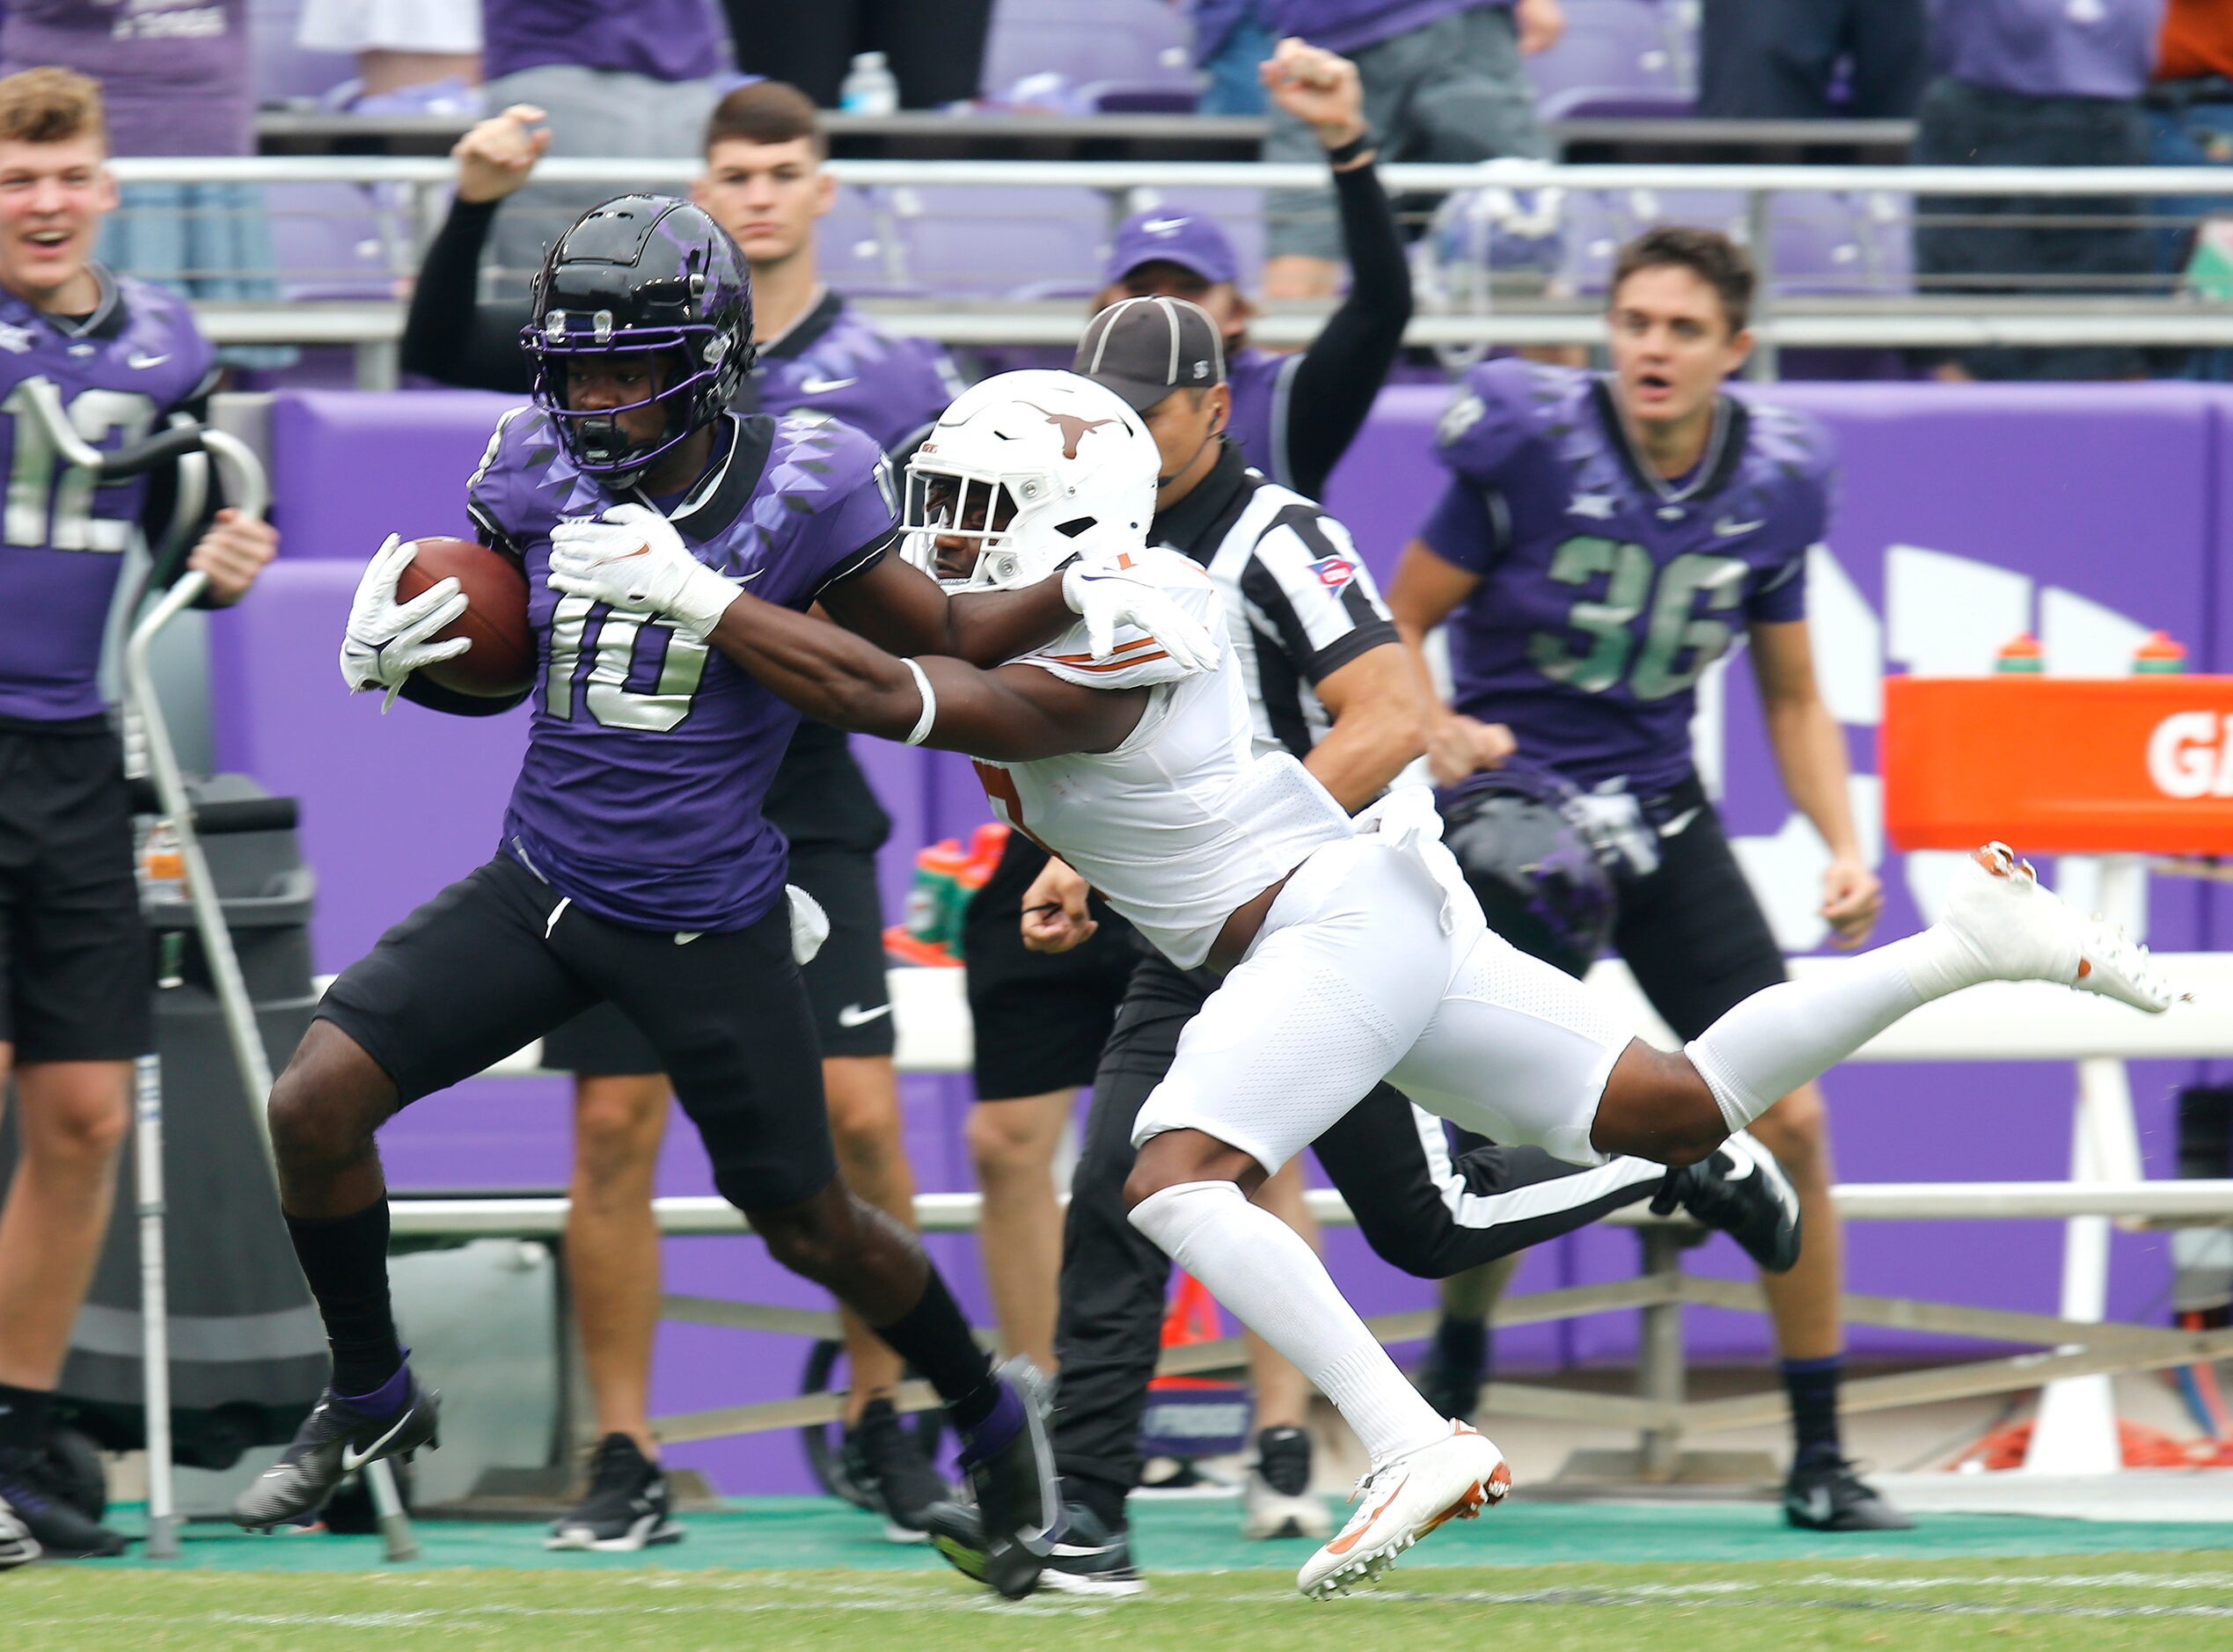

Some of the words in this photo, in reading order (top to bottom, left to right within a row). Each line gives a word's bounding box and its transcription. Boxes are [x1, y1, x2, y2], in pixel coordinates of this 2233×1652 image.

[546, 593, 710, 732] 10
[1526, 535, 1749, 700] 36
[2145, 710, 2233, 799] G
